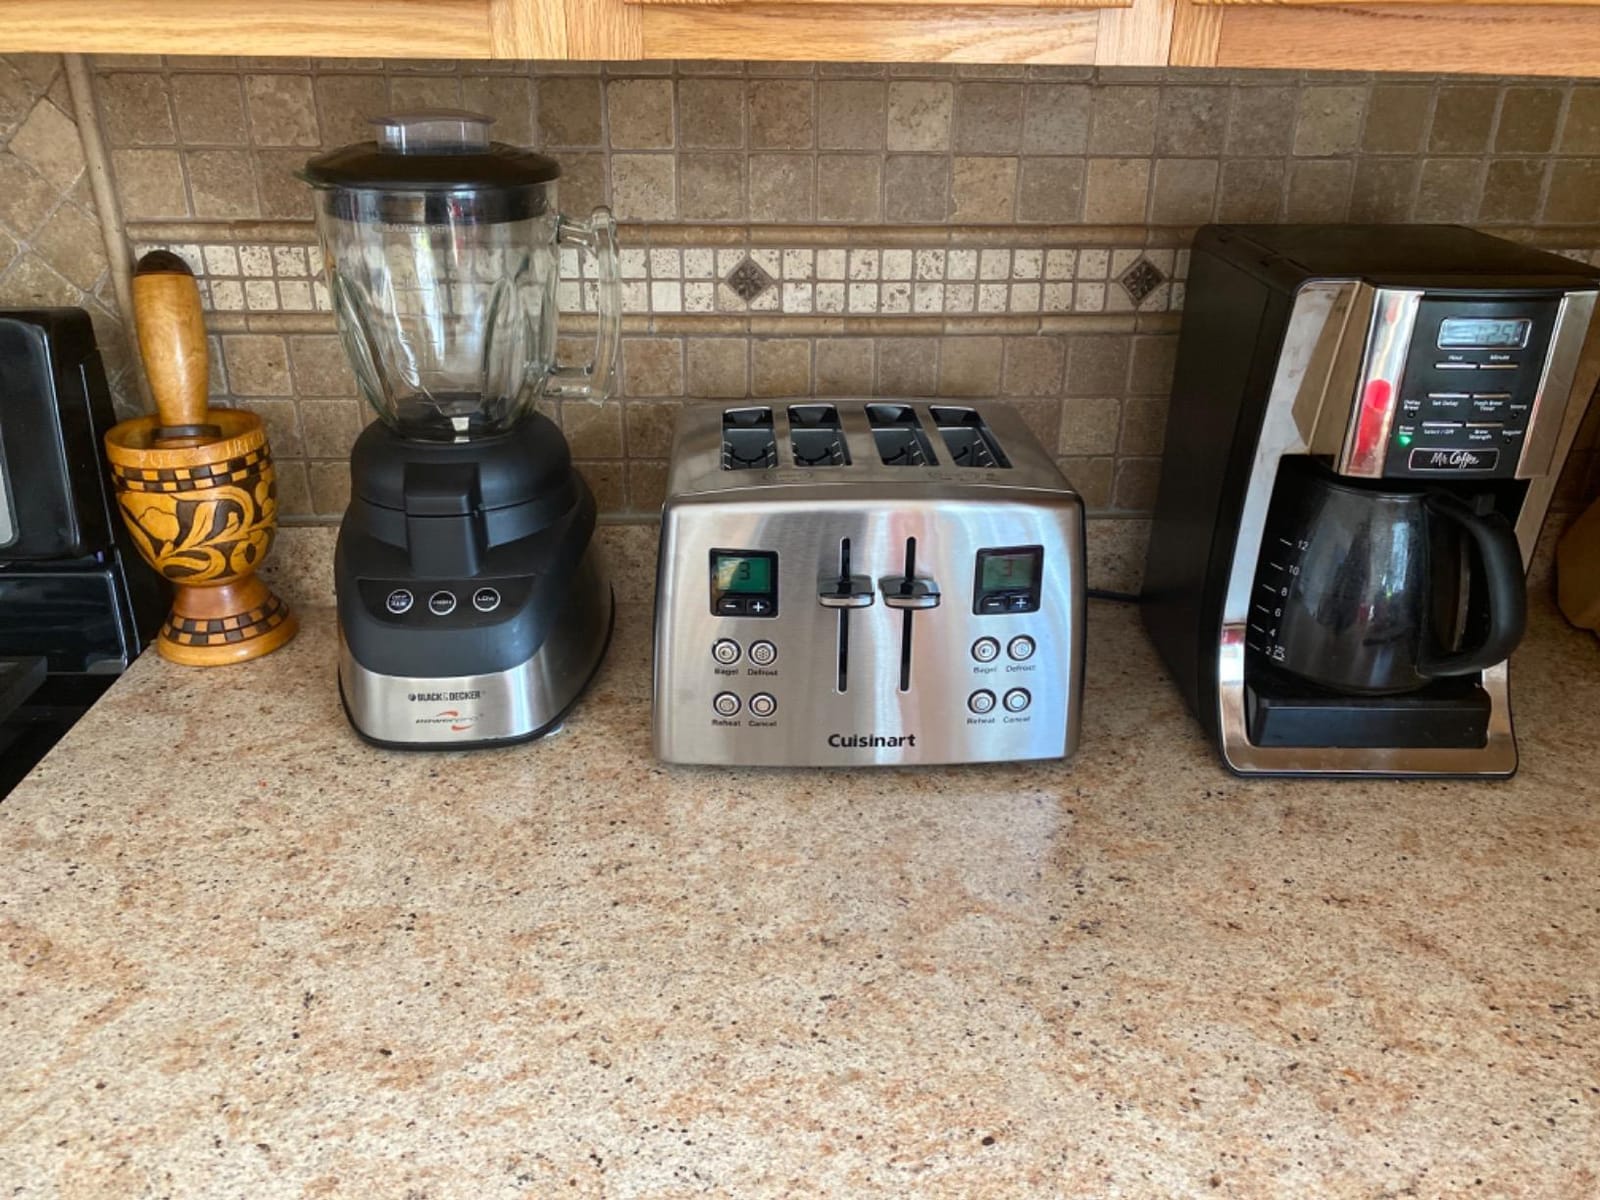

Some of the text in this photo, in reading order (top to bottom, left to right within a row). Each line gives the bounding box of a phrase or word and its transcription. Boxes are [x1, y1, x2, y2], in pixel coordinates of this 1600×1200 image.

[1449, 450, 1480, 469] Coffee
[1298, 540, 1309, 551] 12
[739, 561, 750, 581] 3
[1289, 565, 1300, 576] 10
[1281, 587, 1288, 597] 8
[1275, 608, 1281, 617] 6
[1269, 628, 1277, 637] 4
[1265, 646, 1272, 655] 2
[714, 668, 739, 676] Bagel
[747, 668, 778, 677] Defrost
[973, 666, 997, 674] Bagel
[1006, 664, 1036, 673] Defrost
[712, 719, 741, 727] Reheat
[828, 733, 916, 748] Cuisinart
